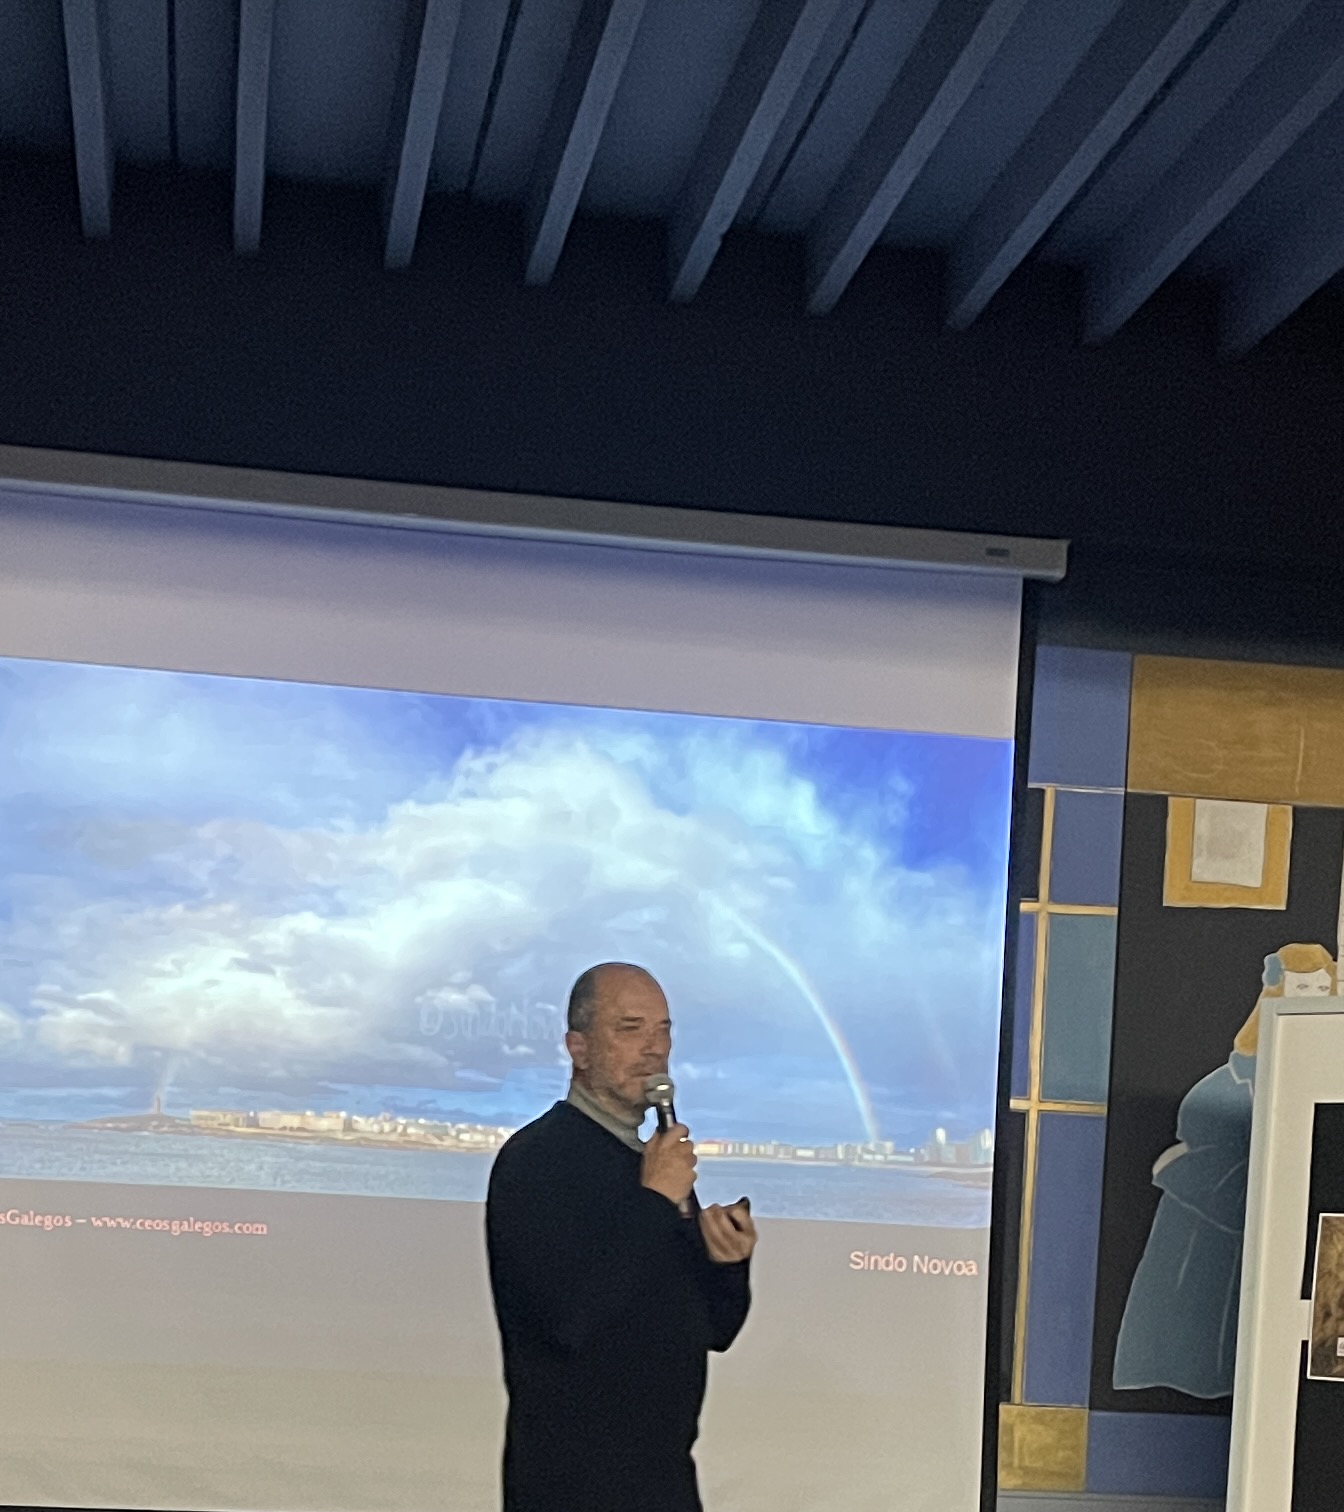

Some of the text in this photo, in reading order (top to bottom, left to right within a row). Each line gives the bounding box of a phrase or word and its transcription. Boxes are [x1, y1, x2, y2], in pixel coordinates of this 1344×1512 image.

[91, 1216, 268, 1237] www.ceosgalegos.com
[849, 1250, 979, 1276] Sindo Novoa
